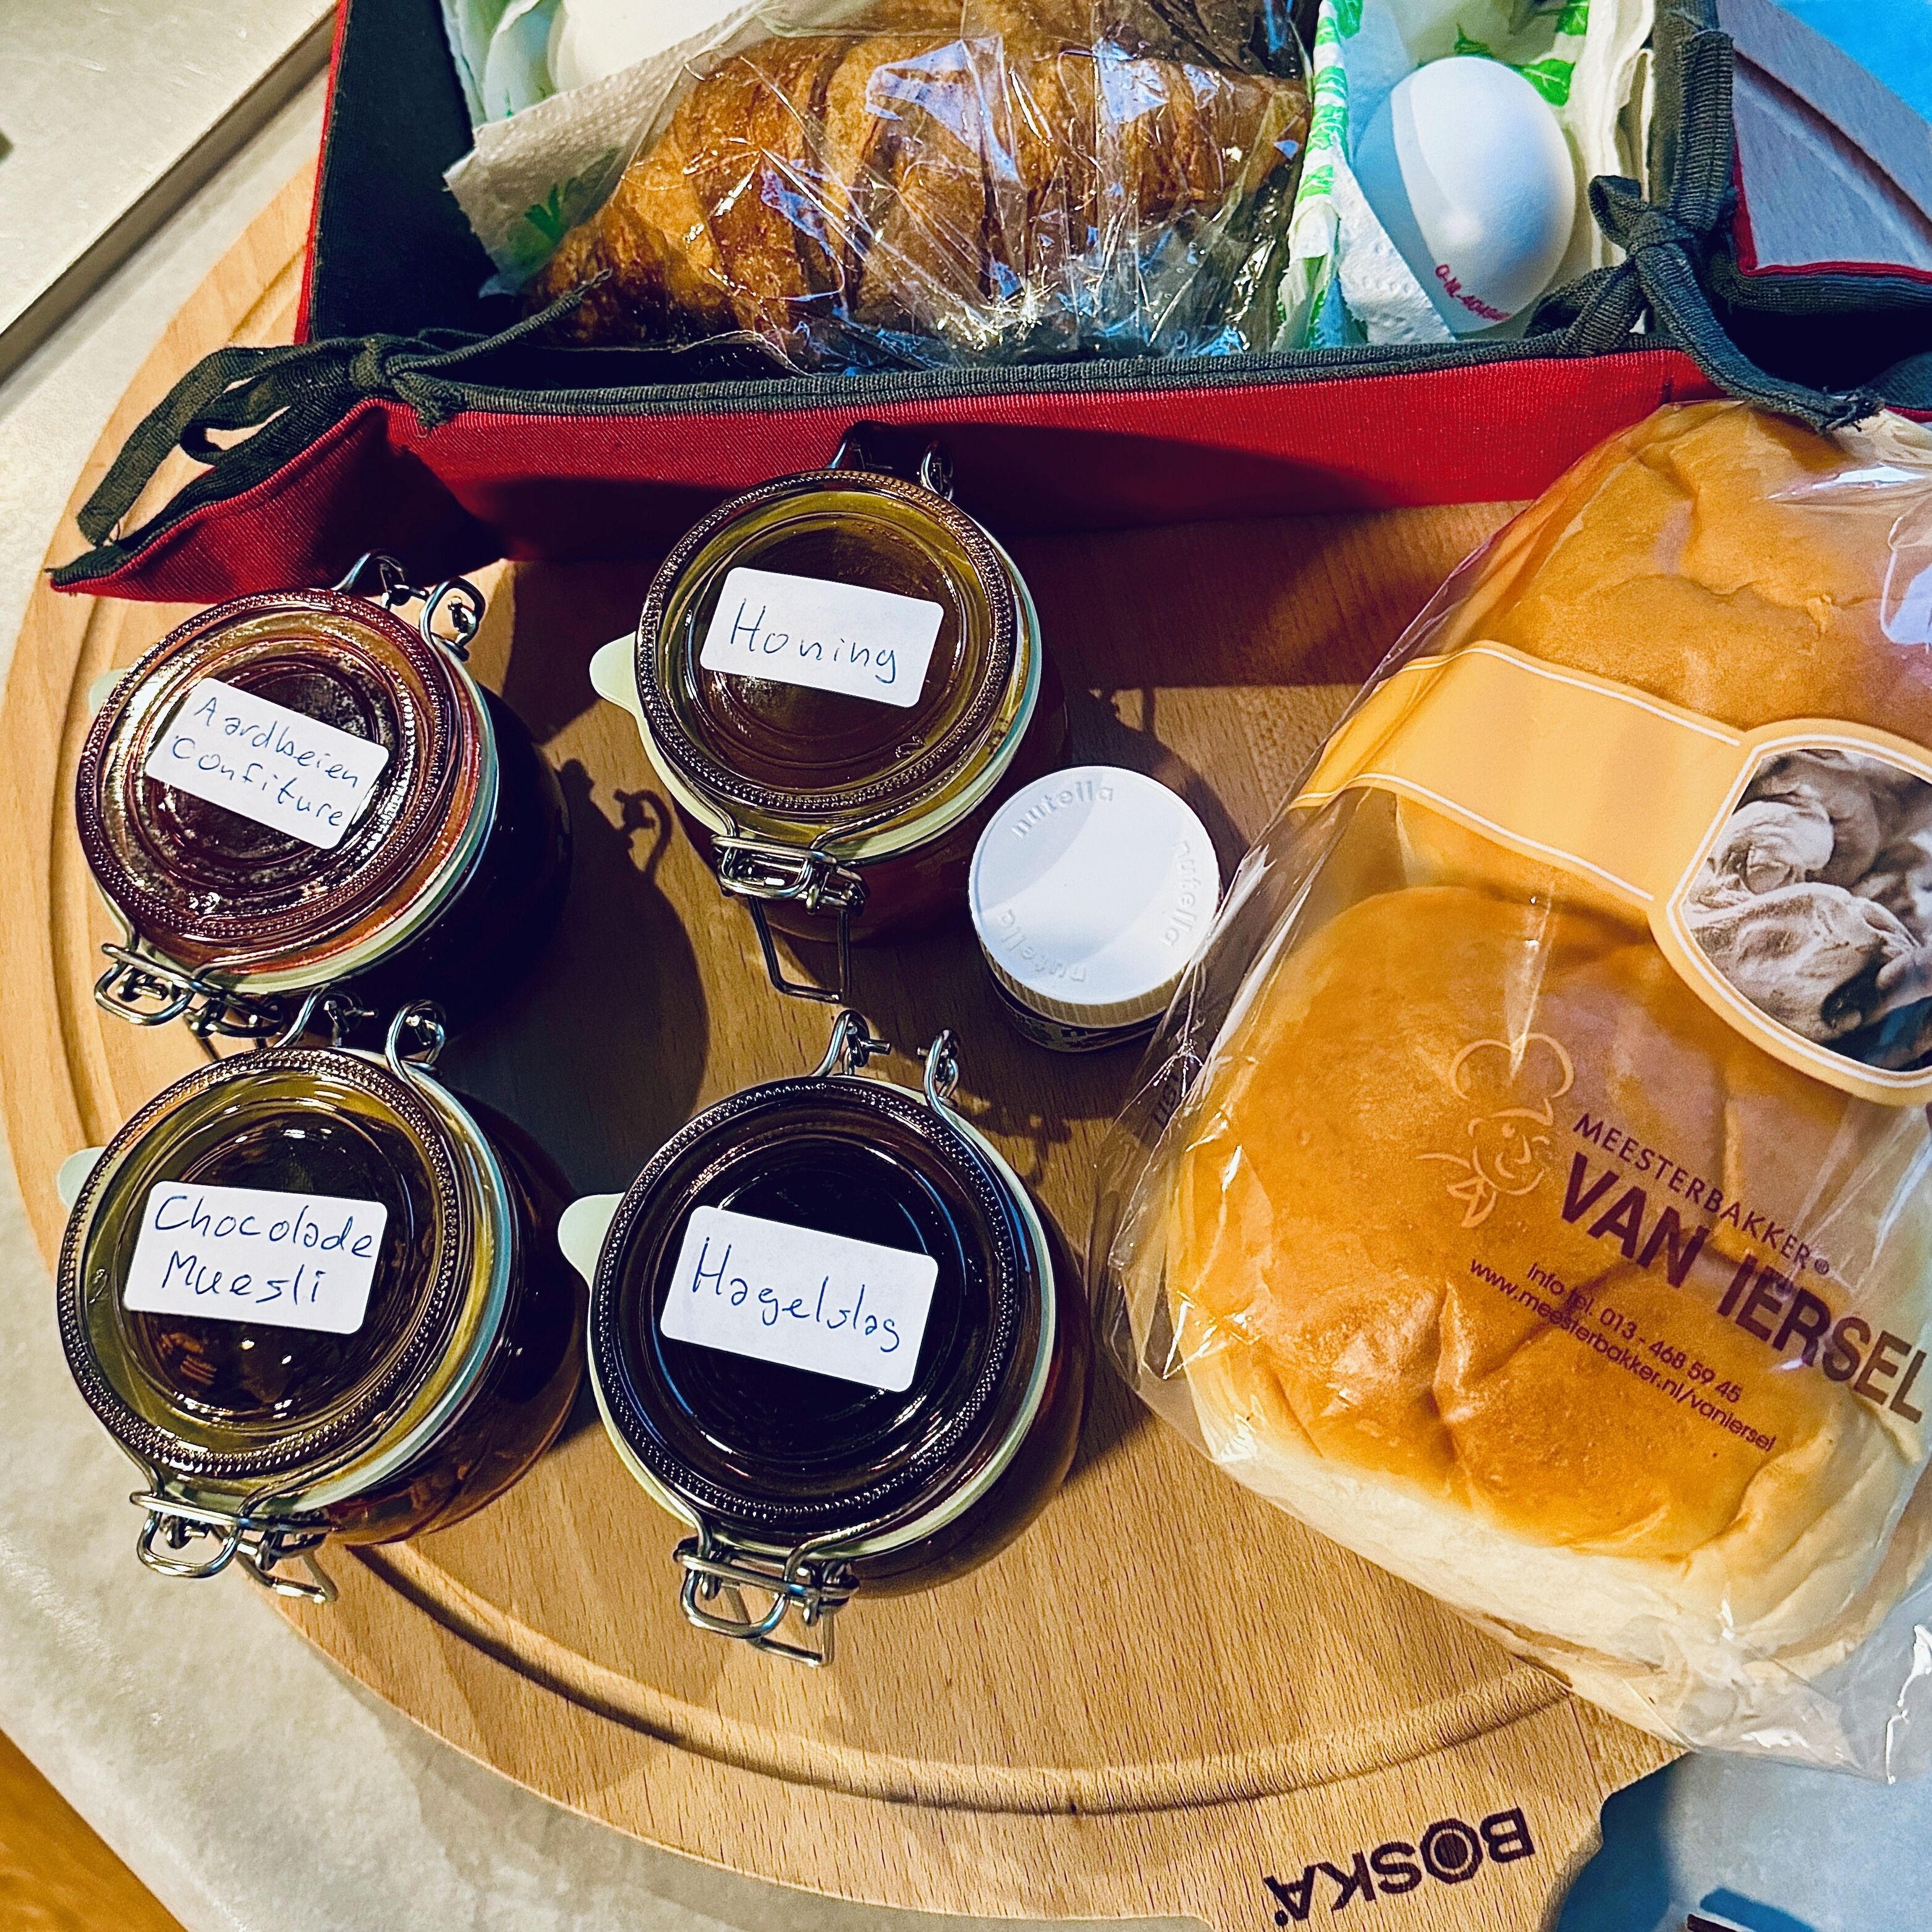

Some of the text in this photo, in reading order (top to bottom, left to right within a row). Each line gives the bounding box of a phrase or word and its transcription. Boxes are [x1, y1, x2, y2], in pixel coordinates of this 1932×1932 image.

[730, 597, 896, 684] Honing
[172, 735, 343, 827] Confiture
[193, 696, 359, 788] Aardbeien
[1011, 780, 1115, 840] nutella
[1162, 840, 1202, 947] nutella
[997, 909, 1087, 982] nutella
[155, 1195, 374, 1258] Chocolade
[162, 1250, 326, 1306] Muesli
[692, 1236, 900, 1353] Hagelslag
[1561, 1152, 1928, 1424] VAN IERSEL
[1470, 1258, 1777, 1452] www.meesterbakker.nl/vaniersel
[1526, 1262, 1565, 1295] Info
[1599, 1308, 1638, 1340] 013
[1648, 1340, 1687, 1370] 468
[1687, 1361, 1716, 1384] 59
[1715, 1380, 1743, 1403] 45
